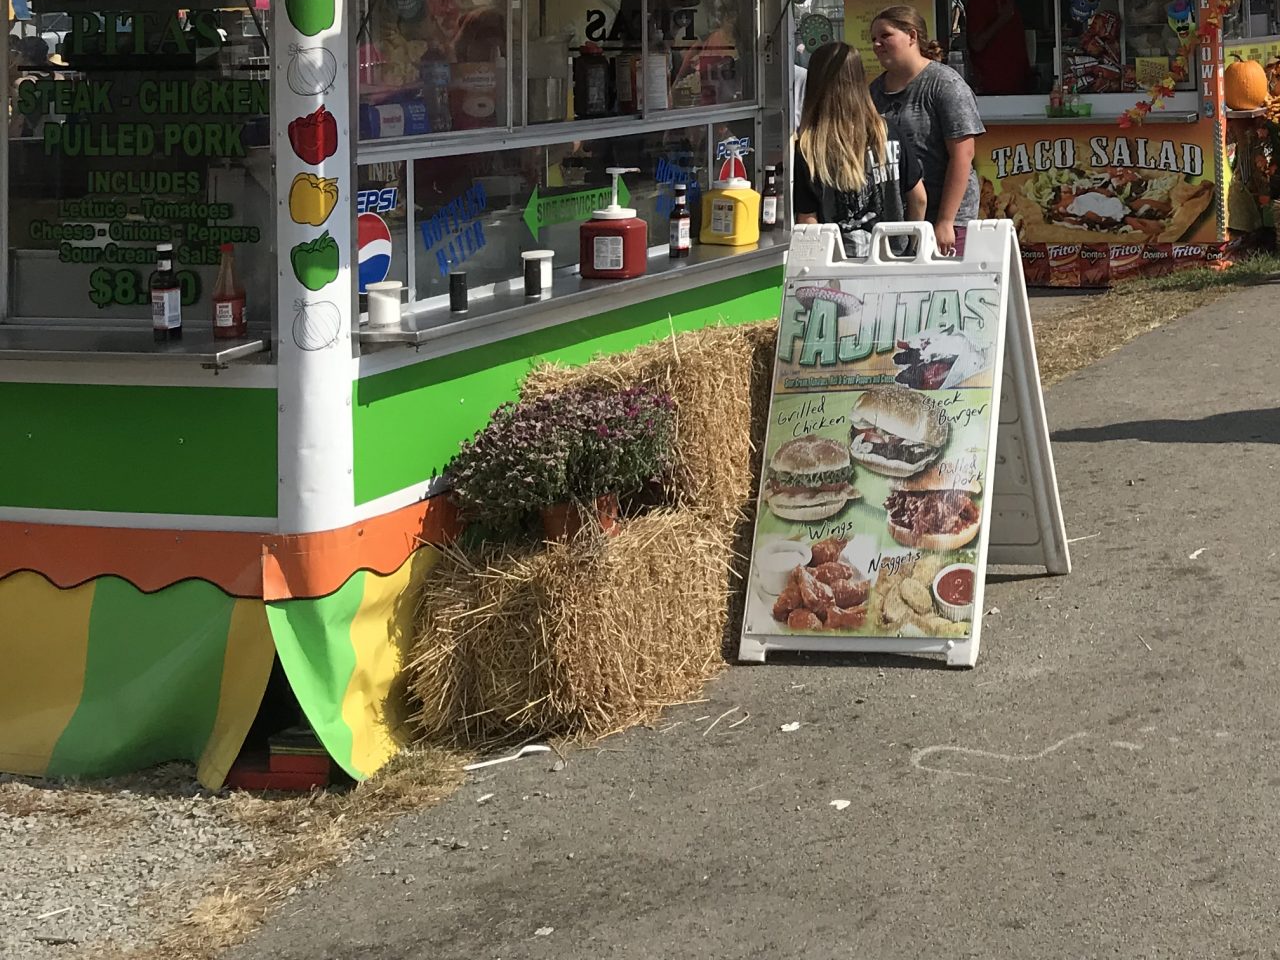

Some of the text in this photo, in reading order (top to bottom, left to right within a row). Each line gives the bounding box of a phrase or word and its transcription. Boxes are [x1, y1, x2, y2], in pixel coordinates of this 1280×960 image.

[67, 7, 223, 56] PITAS
[17, 79, 270, 115] STEAK CHICKEN
[43, 122, 247, 158] PULLED PORK
[991, 136, 1205, 180] TACO SALAD
[87, 170, 201, 194] INCLUDES
[58, 199, 231, 220] Lettuce Tomatoes
[357, 187, 398, 213] EPSI
[29, 220, 261, 245] Cheese Onions Peppers
[59, 243, 105, 264] Sour
[1080, 249, 1107, 260] Doritos
[1142, 250, 1168, 261] Doritos
[89, 267, 202, 309] $8.0
[778, 287, 1000, 367] FAJITAS
[777, 395, 826, 426] Grilled
[921, 390, 965, 414] Steak
[792, 414, 846, 438] Chicken
[937, 403, 988, 427] Burger
[953, 471, 984, 490] Pork
[807, 521, 854, 541] Wings
[868, 551, 921, 574] Nuggets
